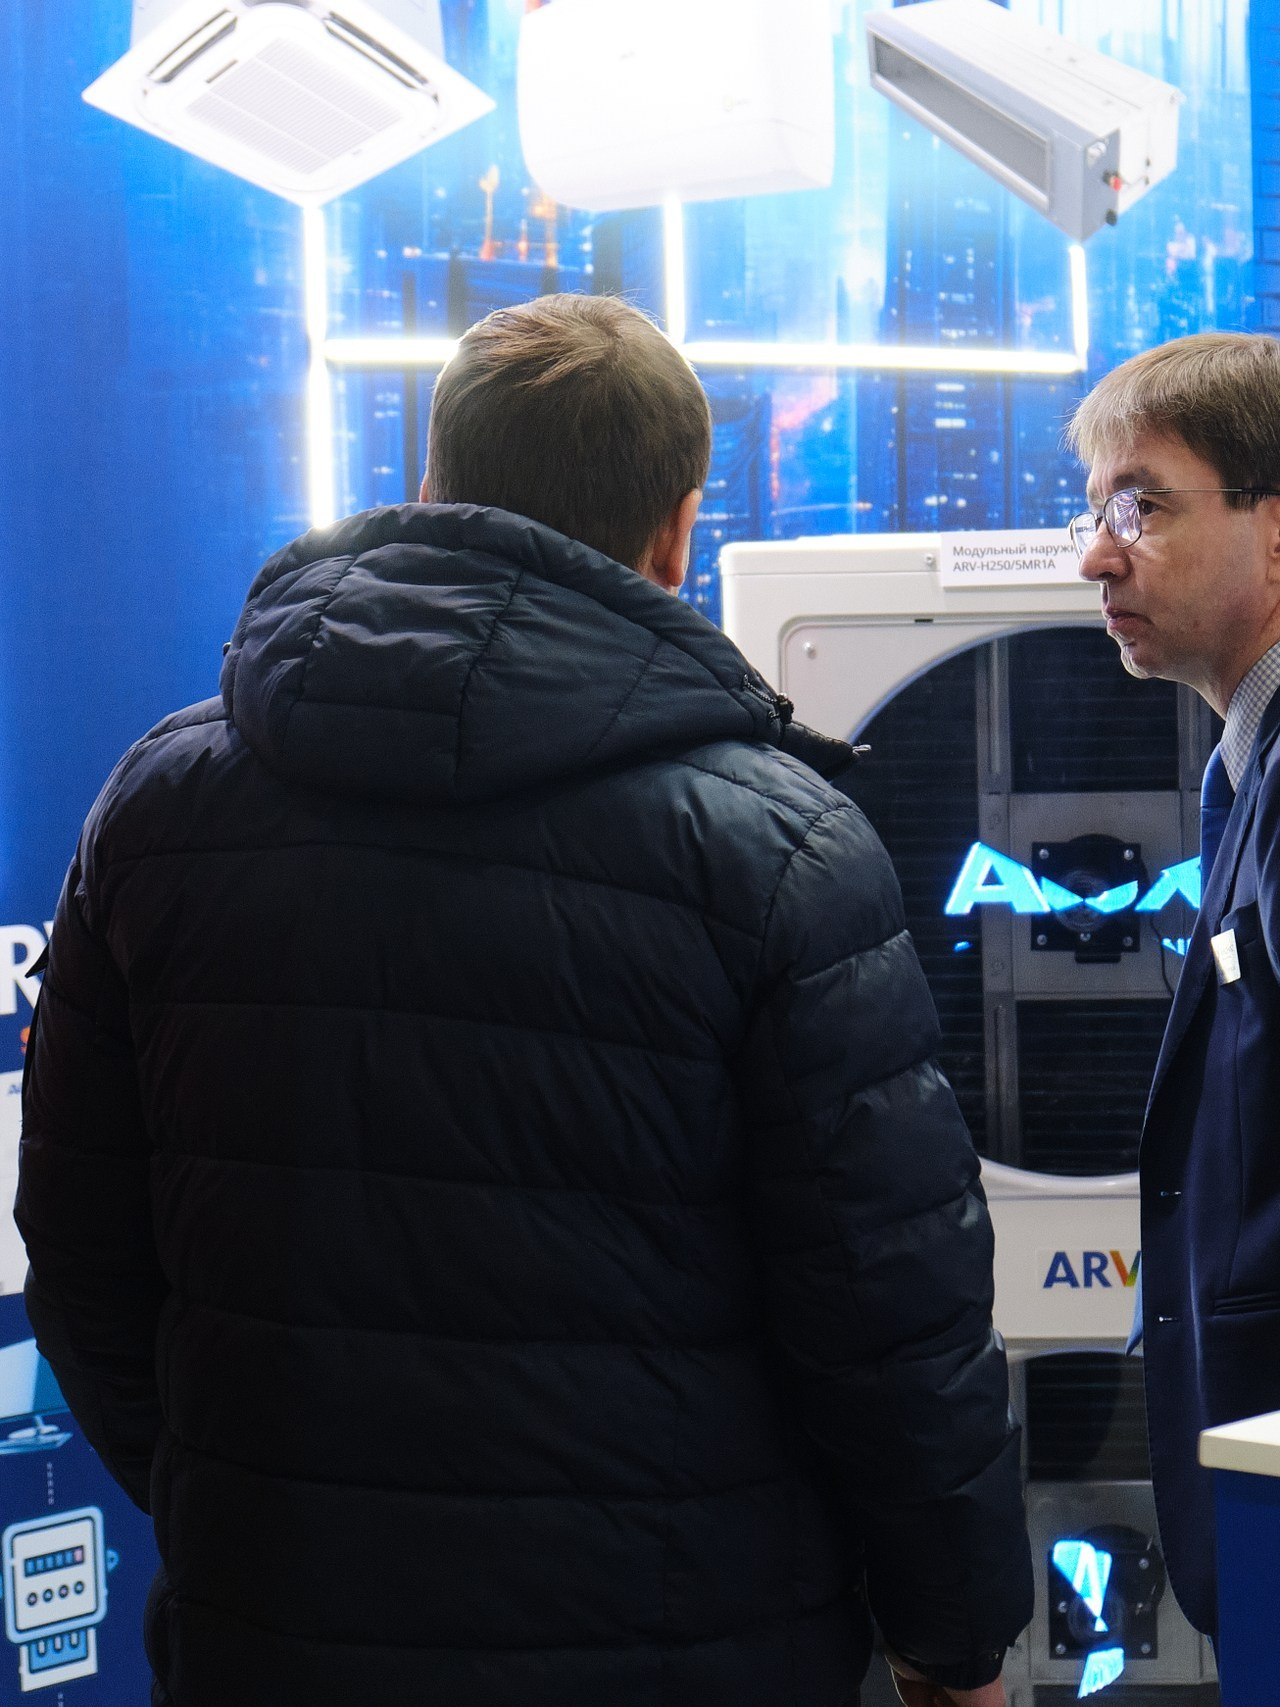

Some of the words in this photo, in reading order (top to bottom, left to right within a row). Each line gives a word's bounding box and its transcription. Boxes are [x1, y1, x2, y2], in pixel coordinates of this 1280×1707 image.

[953, 543, 1027, 558] Модульный
[953, 558, 1056, 572] ARV-H250/5MR1A
[1043, 1250, 1142, 1289] ARV
